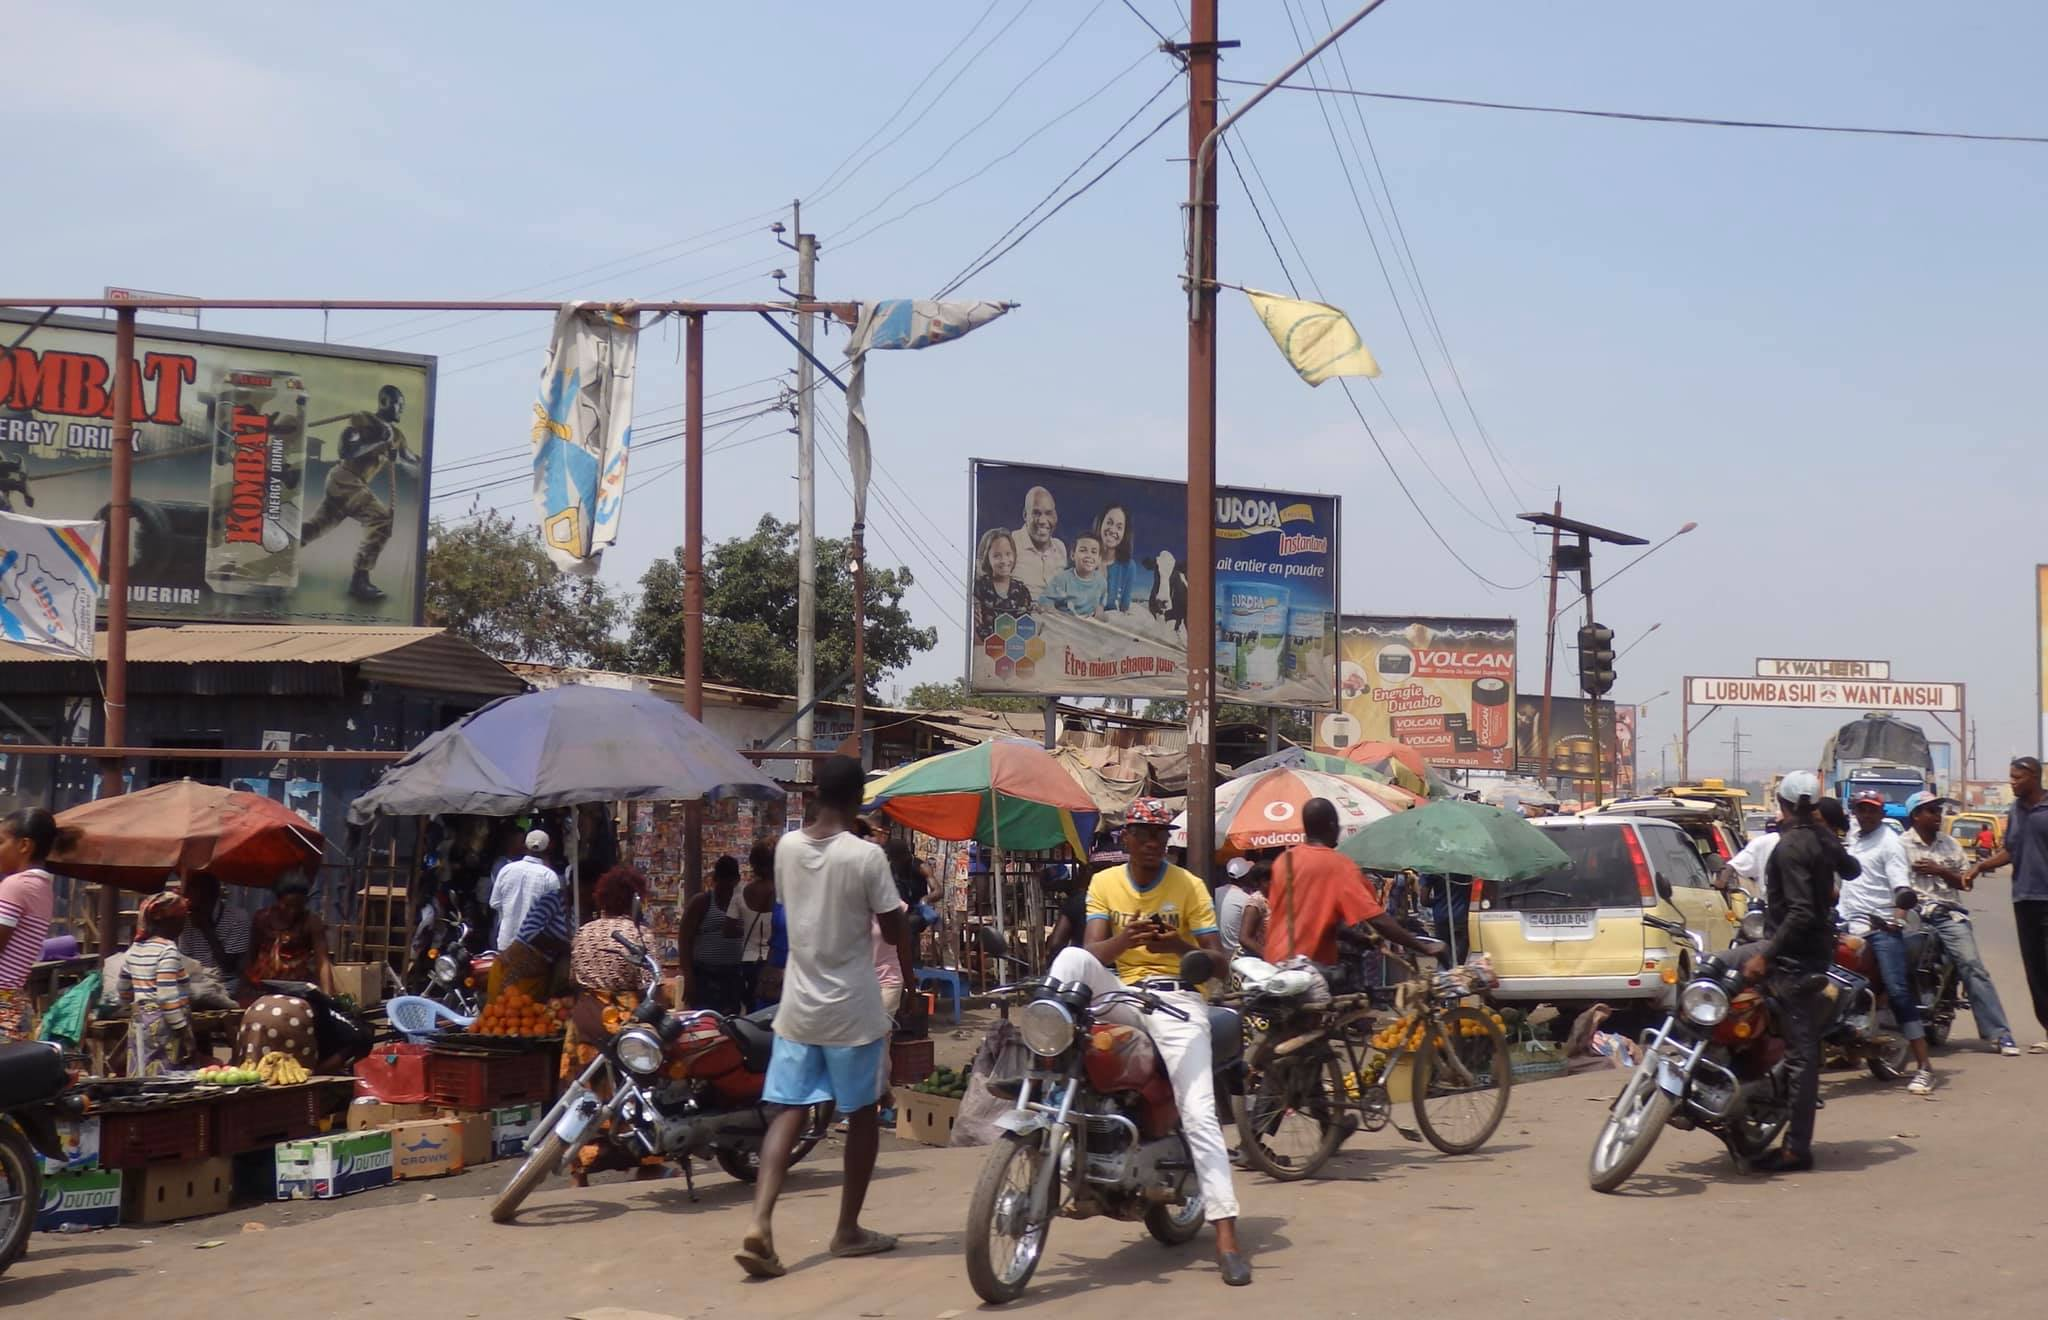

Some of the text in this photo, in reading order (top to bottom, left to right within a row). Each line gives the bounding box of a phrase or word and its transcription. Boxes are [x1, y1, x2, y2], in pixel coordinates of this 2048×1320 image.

[225, 404, 269, 544] KOMBAT
[268, 439, 284, 520] ENERGY DRINK
[1216, 557, 1324, 579] ait entier en poudre
[1064, 645, 1176, 678] Être mieux chaque jour
[1418, 651, 1514, 668] VOLCAN
[1776, 661, 1870, 677] KWAHERI
[1374, 683, 1422, 700] Energie
[1705, 682, 1943, 706] LUBUMBASHI WANTANSHI
[1388, 695, 1441, 712] Durable
[1396, 718, 1442, 728] VOLCAN
[1481, 707, 1489, 745] VOLCAN
[1406, 735, 1452, 745] VOLCAN
[1458, 757, 1479, 765] main
[355, 1151, 391, 1171] DUTOIT
[401, 1153, 449, 1166] CROWN
[64, 1191, 116, 1208] DUTOIT
